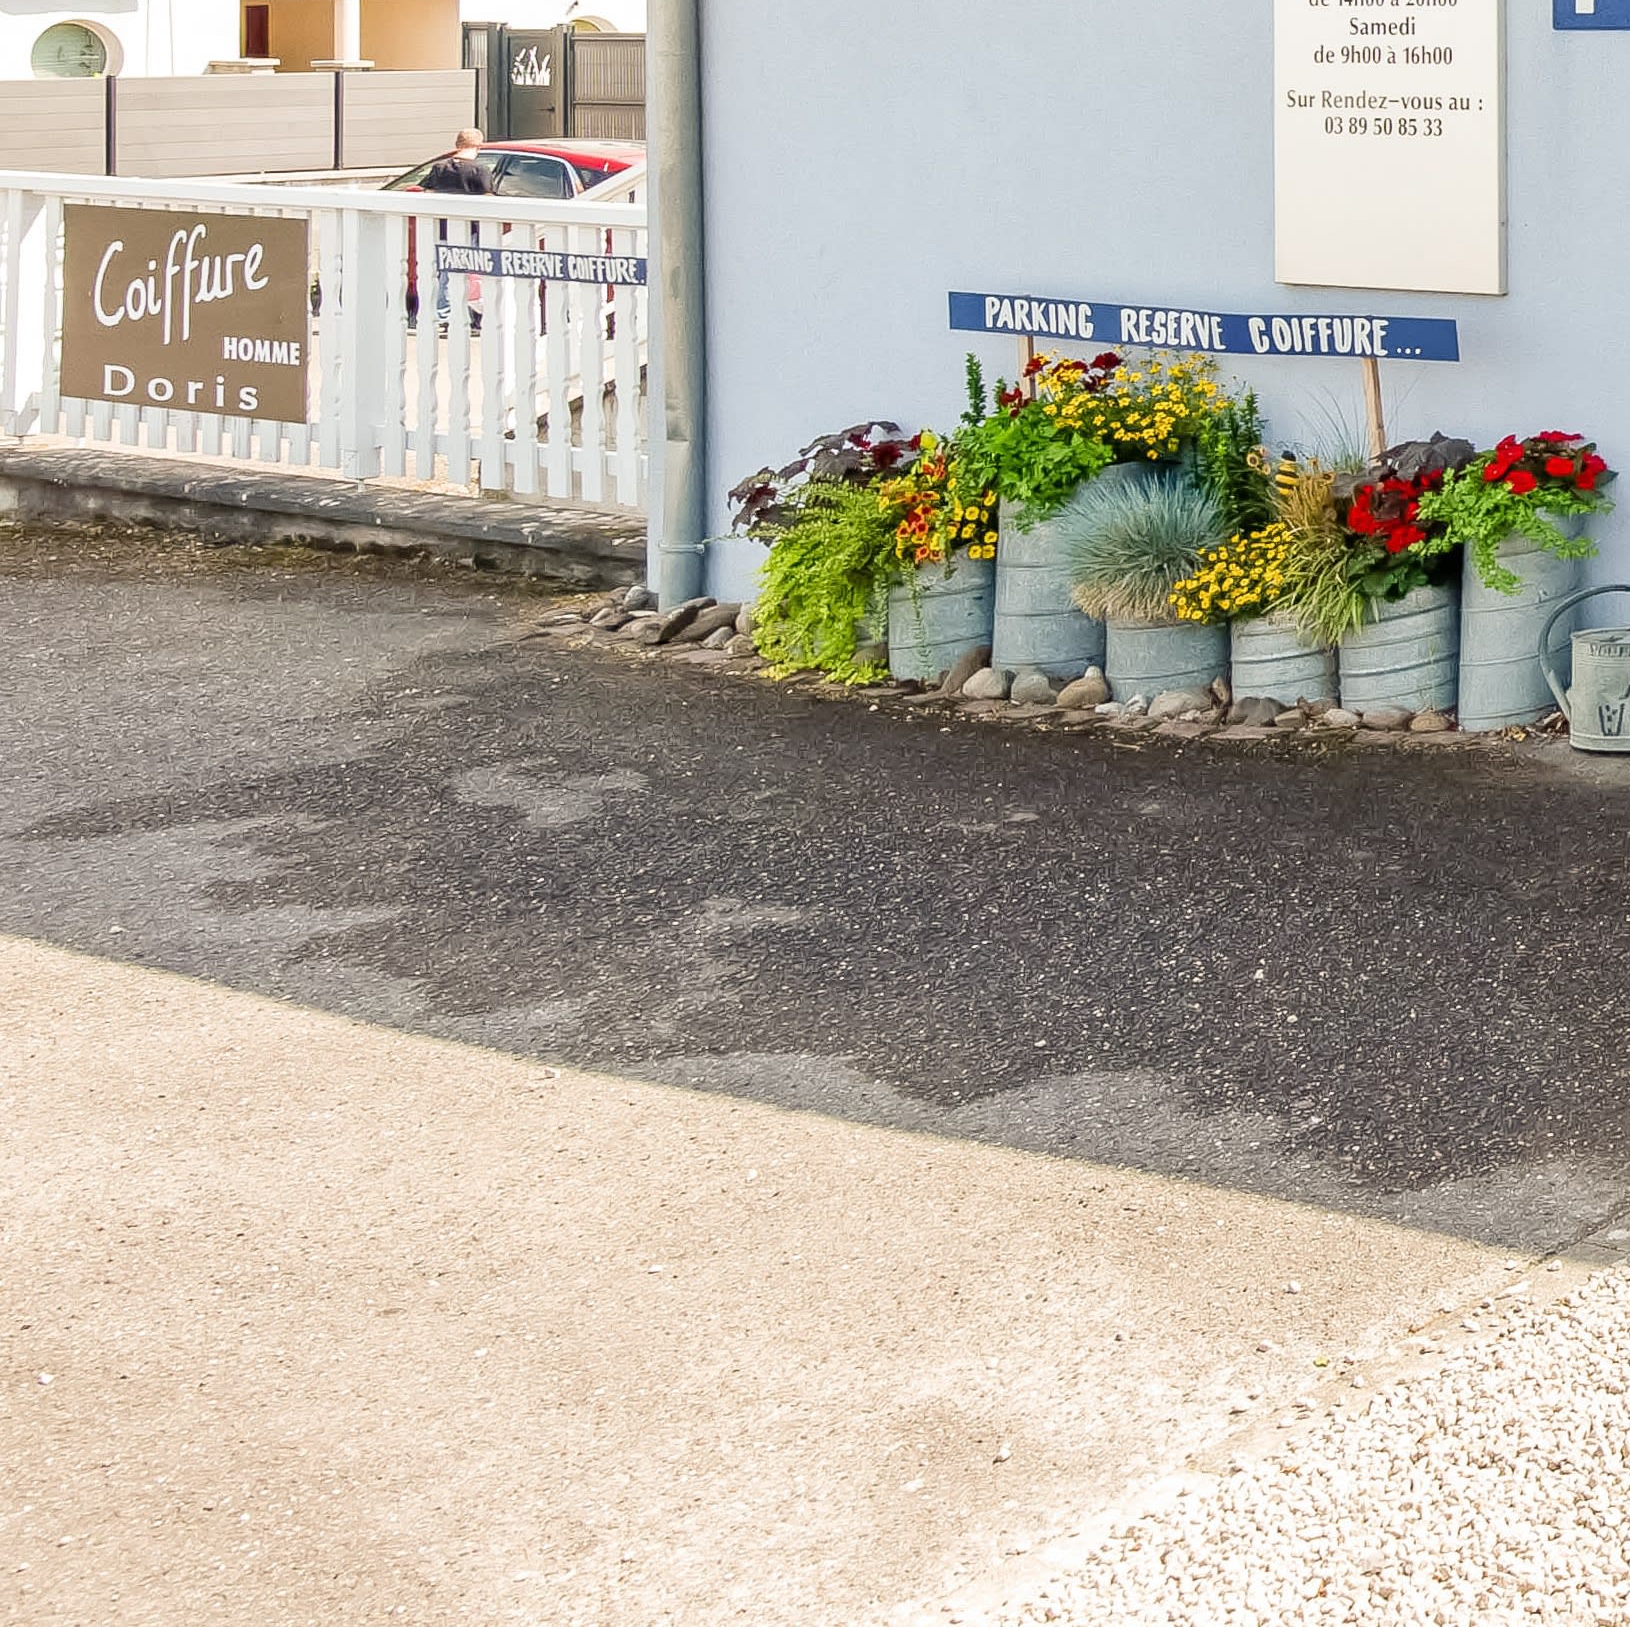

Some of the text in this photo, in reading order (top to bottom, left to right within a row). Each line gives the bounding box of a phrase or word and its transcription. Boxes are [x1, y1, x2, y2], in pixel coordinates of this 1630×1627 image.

[1349, 17, 1416, 35] Samedi
[1314, 46, 1453, 64] de 9h00 à 16h00
[1287, 90, 1316, 108] Sur
[1321, 91, 1442, 110] Rendez-vous
[1449, 96, 1471, 111] au
[1325, 117, 1442, 136] 03 89 50 85 33
[438, 246, 494, 275] PARKING
[501, 250, 563, 280] RESERVE
[93, 223, 270, 344] Coiffure
[984, 295, 1094, 339] PARKING
[1120, 307, 1226, 350] RESERVE
[223, 336, 301, 367] HOMME
[103, 364, 259, 411] Doris
